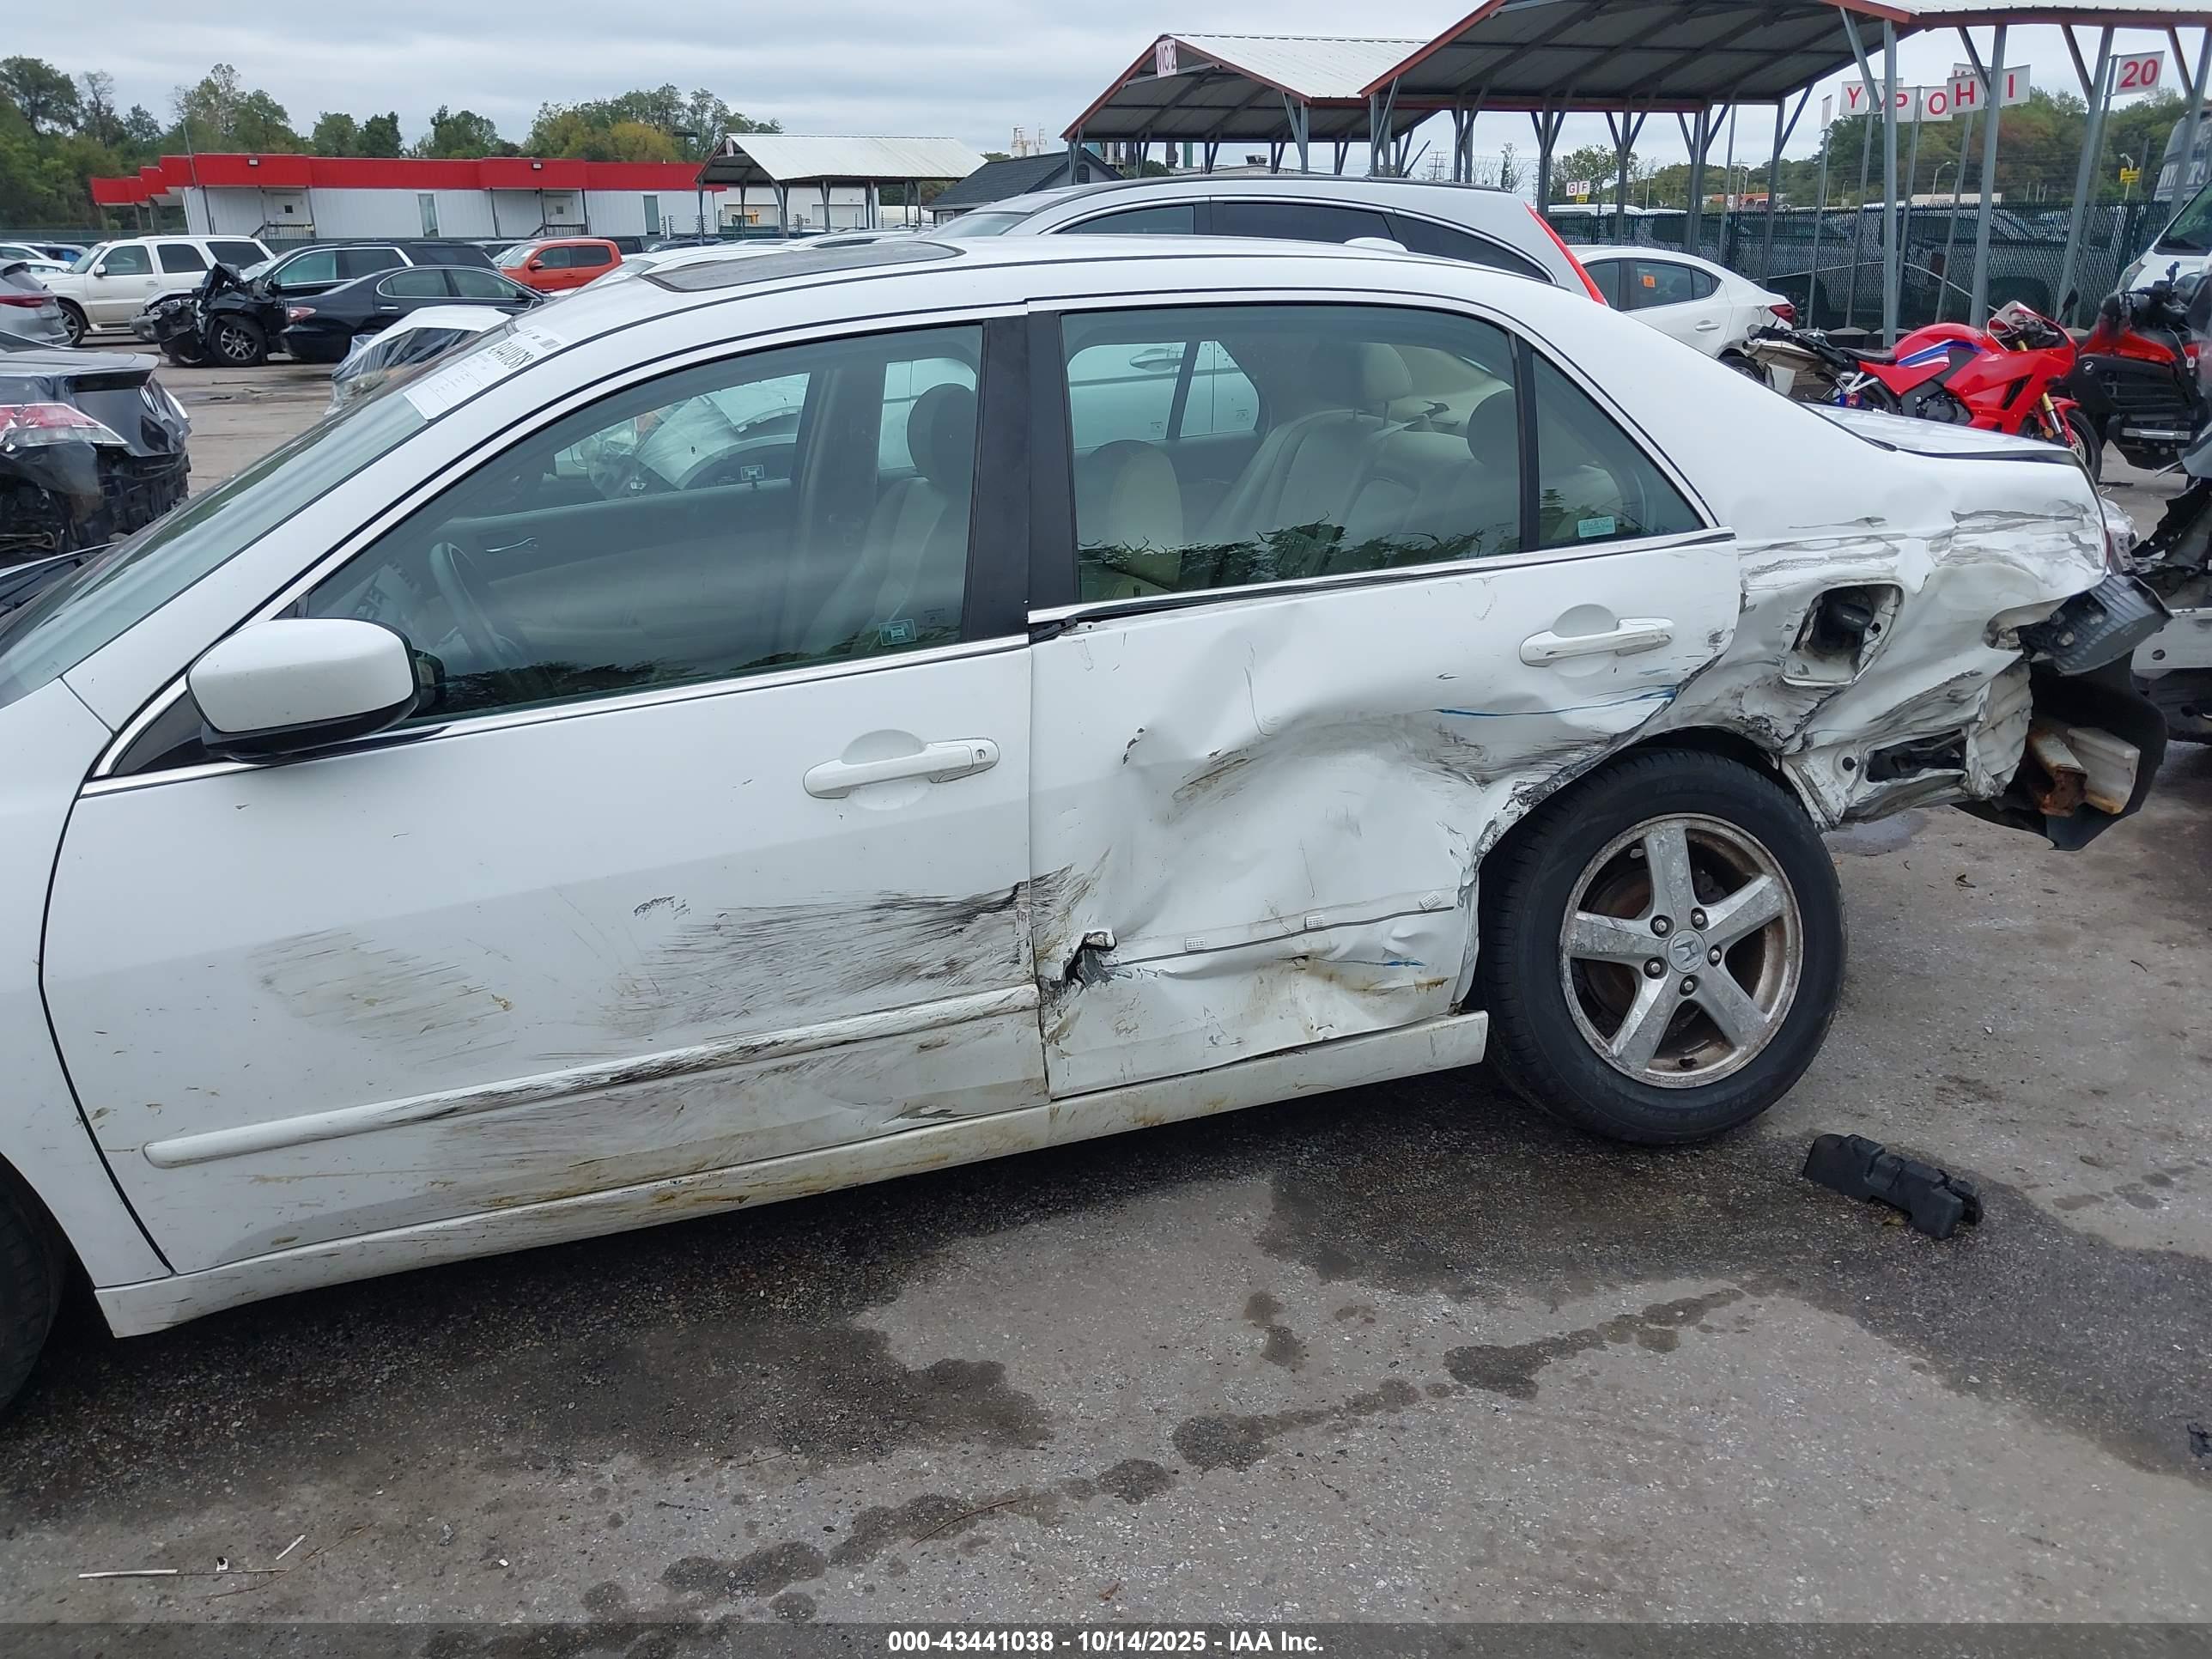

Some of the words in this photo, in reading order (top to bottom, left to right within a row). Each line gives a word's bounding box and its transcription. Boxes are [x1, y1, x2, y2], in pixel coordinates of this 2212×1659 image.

[2118, 58, 2159, 88] 20
[1846, 86, 1863, 109] Y
[1955, 81, 1975, 106] H
[1568, 184, 1576, 194] G
[1582, 182, 1588, 193] F
